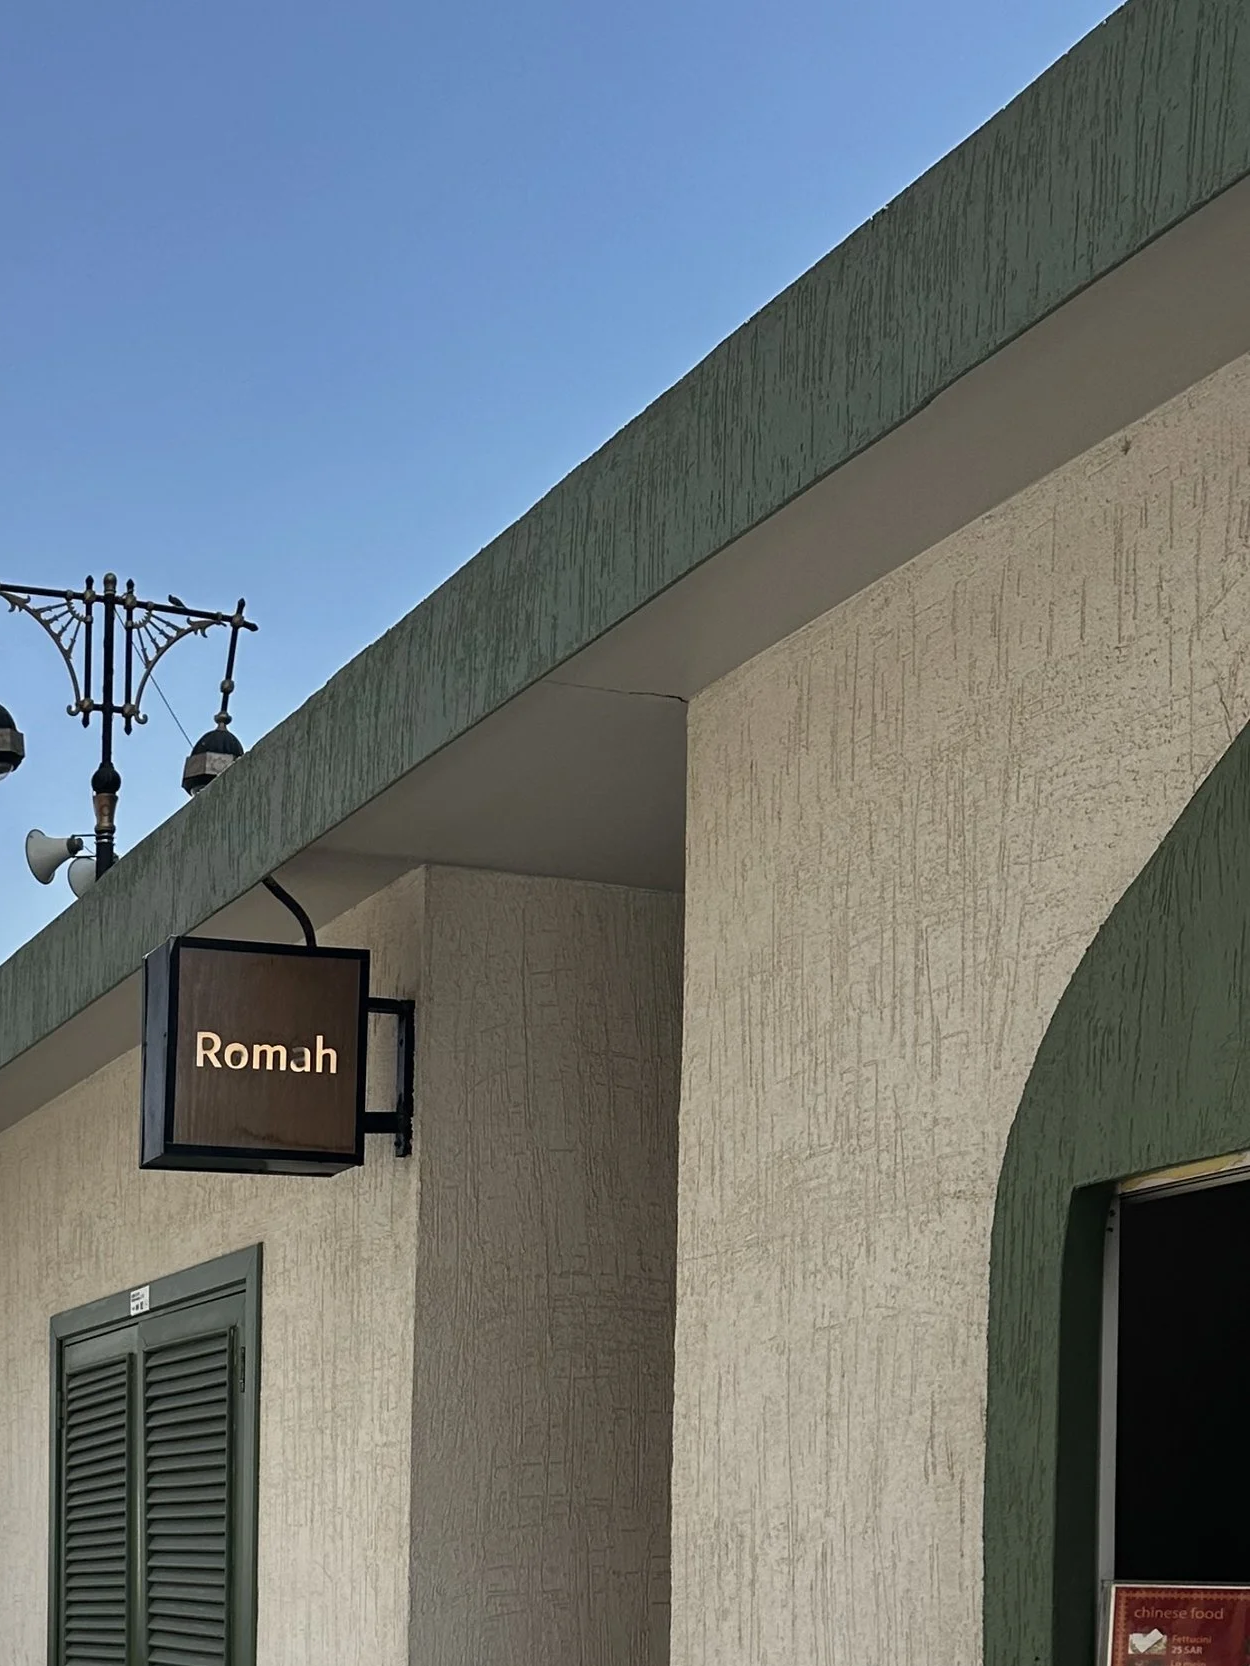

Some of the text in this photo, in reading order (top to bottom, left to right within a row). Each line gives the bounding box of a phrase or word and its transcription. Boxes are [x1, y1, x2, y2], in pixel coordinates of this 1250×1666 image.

[195, 1031, 338, 1075] Romah
[1134, 1607, 1224, 1620] chinese food
[1171, 1645, 1203, 1655] 25 SAR
